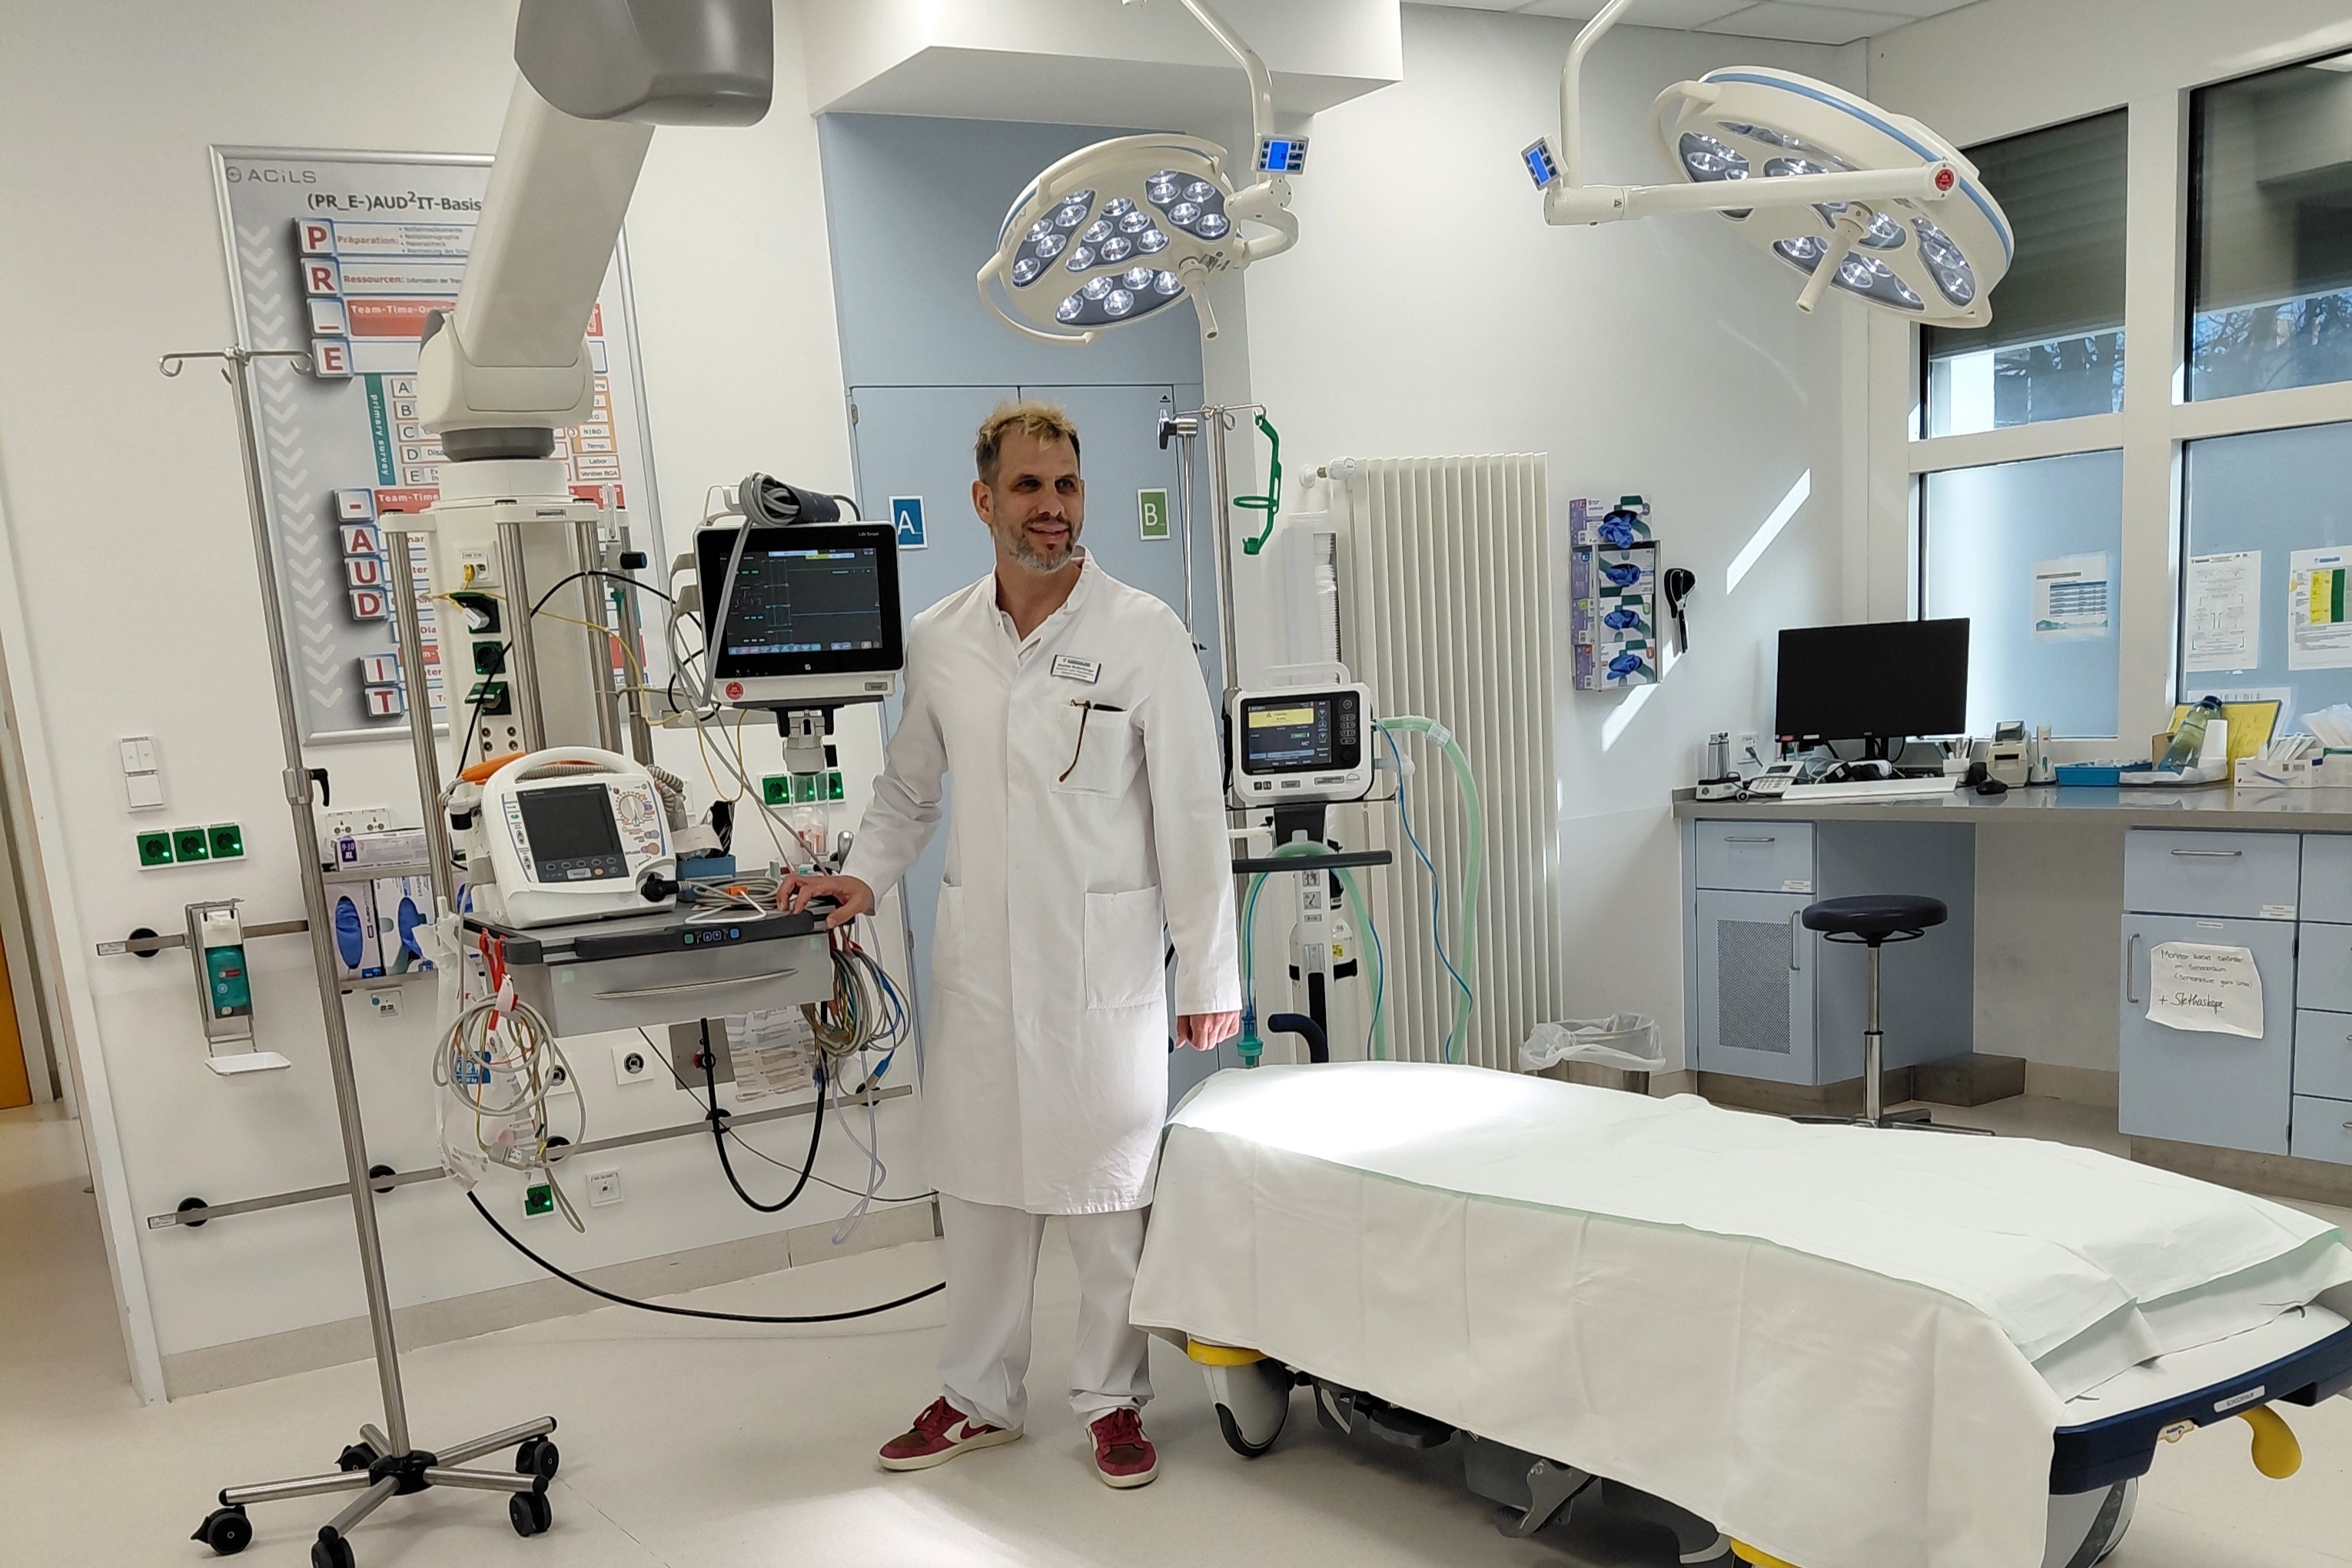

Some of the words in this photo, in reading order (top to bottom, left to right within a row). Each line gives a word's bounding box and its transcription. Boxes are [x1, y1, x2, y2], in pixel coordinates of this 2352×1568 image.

[307, 226, 327, 250] P
[311, 267, 335, 291] R
[344, 274, 404, 284] Ressourcen:
[324, 347, 343, 370] E
[398, 382, 410, 394] A
[401, 405, 412, 416] B
[370, 394, 383, 437] primary
[377, 440, 390, 476] survey
[404, 427, 414, 438] C
[407, 450, 418, 460] D
[410, 470, 420, 482] E
[897, 510, 915, 535] A
[1144, 503, 1158, 526] B
[351, 528, 374, 552] A
[354, 560, 377, 584] U
[376, 659, 384, 681] I
[374, 690, 394, 713] T
